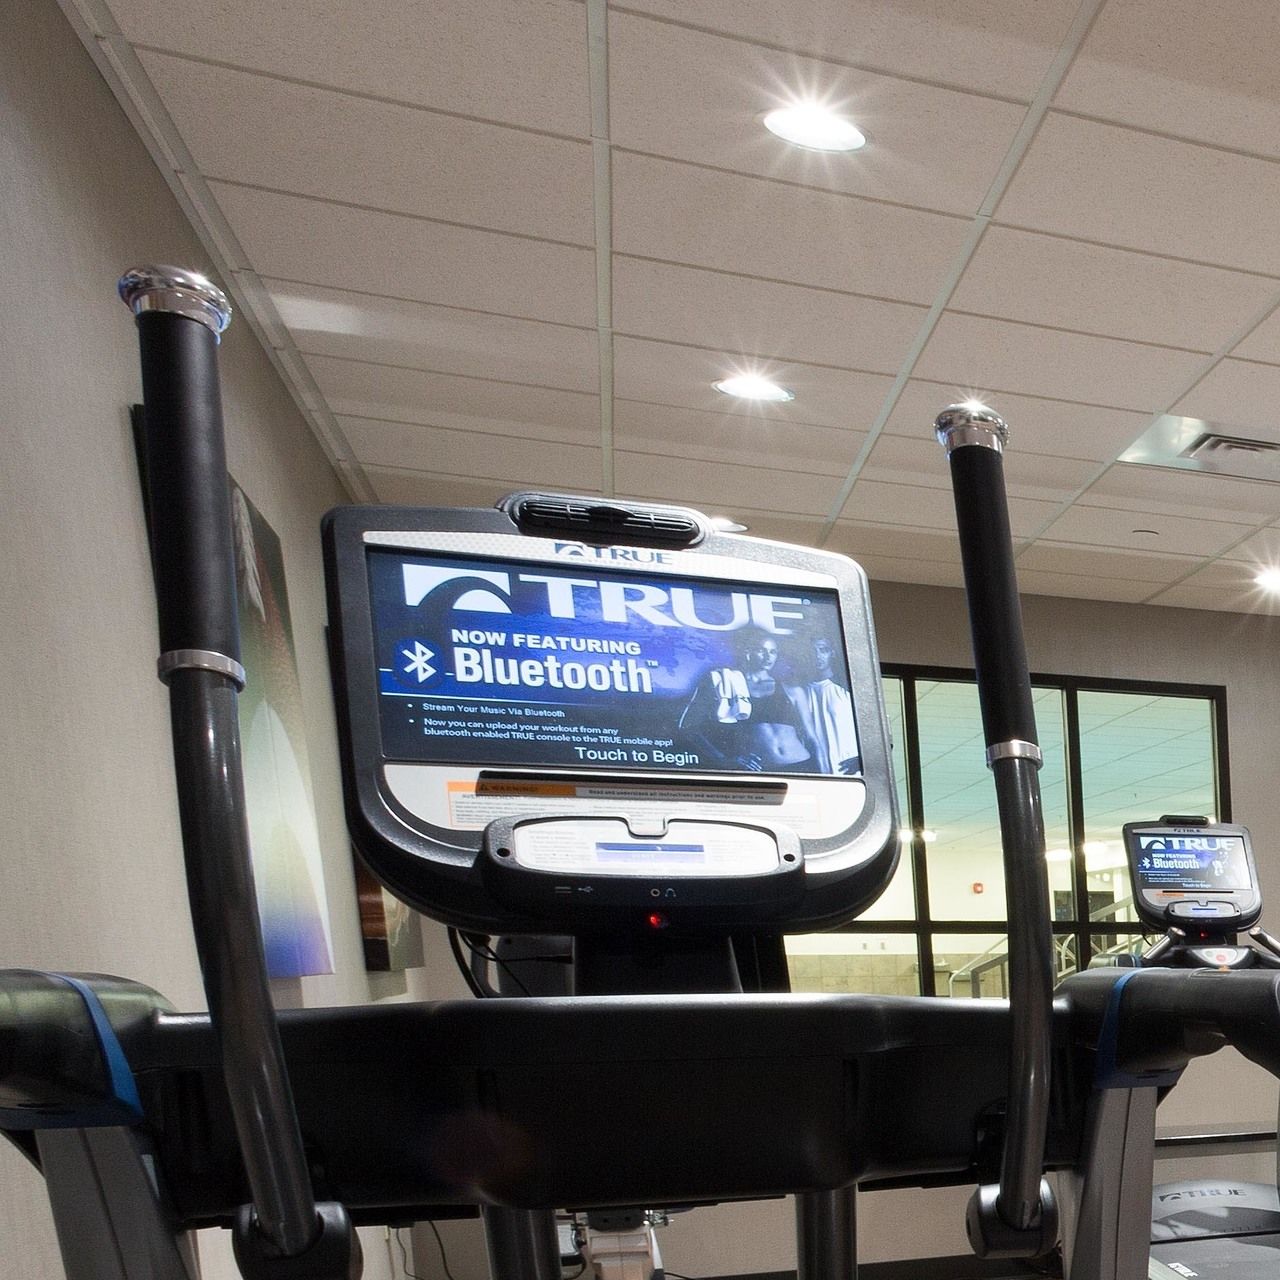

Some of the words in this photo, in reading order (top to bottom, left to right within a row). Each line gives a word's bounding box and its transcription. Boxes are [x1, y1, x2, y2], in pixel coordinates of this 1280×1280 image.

[588, 547, 674, 566] TRUE
[451, 628, 507, 647] NOW
[512, 633, 641, 656] FEATURING
[422, 702, 455, 712] Stream
[457, 705, 479, 714] Your
[480, 706, 506, 715] Music
[508, 707, 523, 716] Via
[524, 709, 566, 718] Bluetooth
[424, 718, 447, 726] Now
[448, 720, 466, 729] you
[486, 722, 518, 731] upload
[542, 725, 579, 734] workout
[580, 725, 602, 734] from
[602, 728, 619, 736] any
[424, 727, 471, 738] bluetooth
[472, 730, 510, 739] enabled
[511, 731, 535, 740] TRUE
[536, 733, 571, 742] console
[583, 735, 598, 743] the
[599, 735, 622, 744] TRUE
[623, 737, 653, 746] mobile
[574, 746, 628, 761] Touch
[631, 749, 648, 762] to
[652, 750, 700, 767] Begin
[1166, 838, 1235, 851] TRUE
[1153, 858, 1200, 870] Bluetooth
[1181, 1189, 1248, 1198] TRUE
